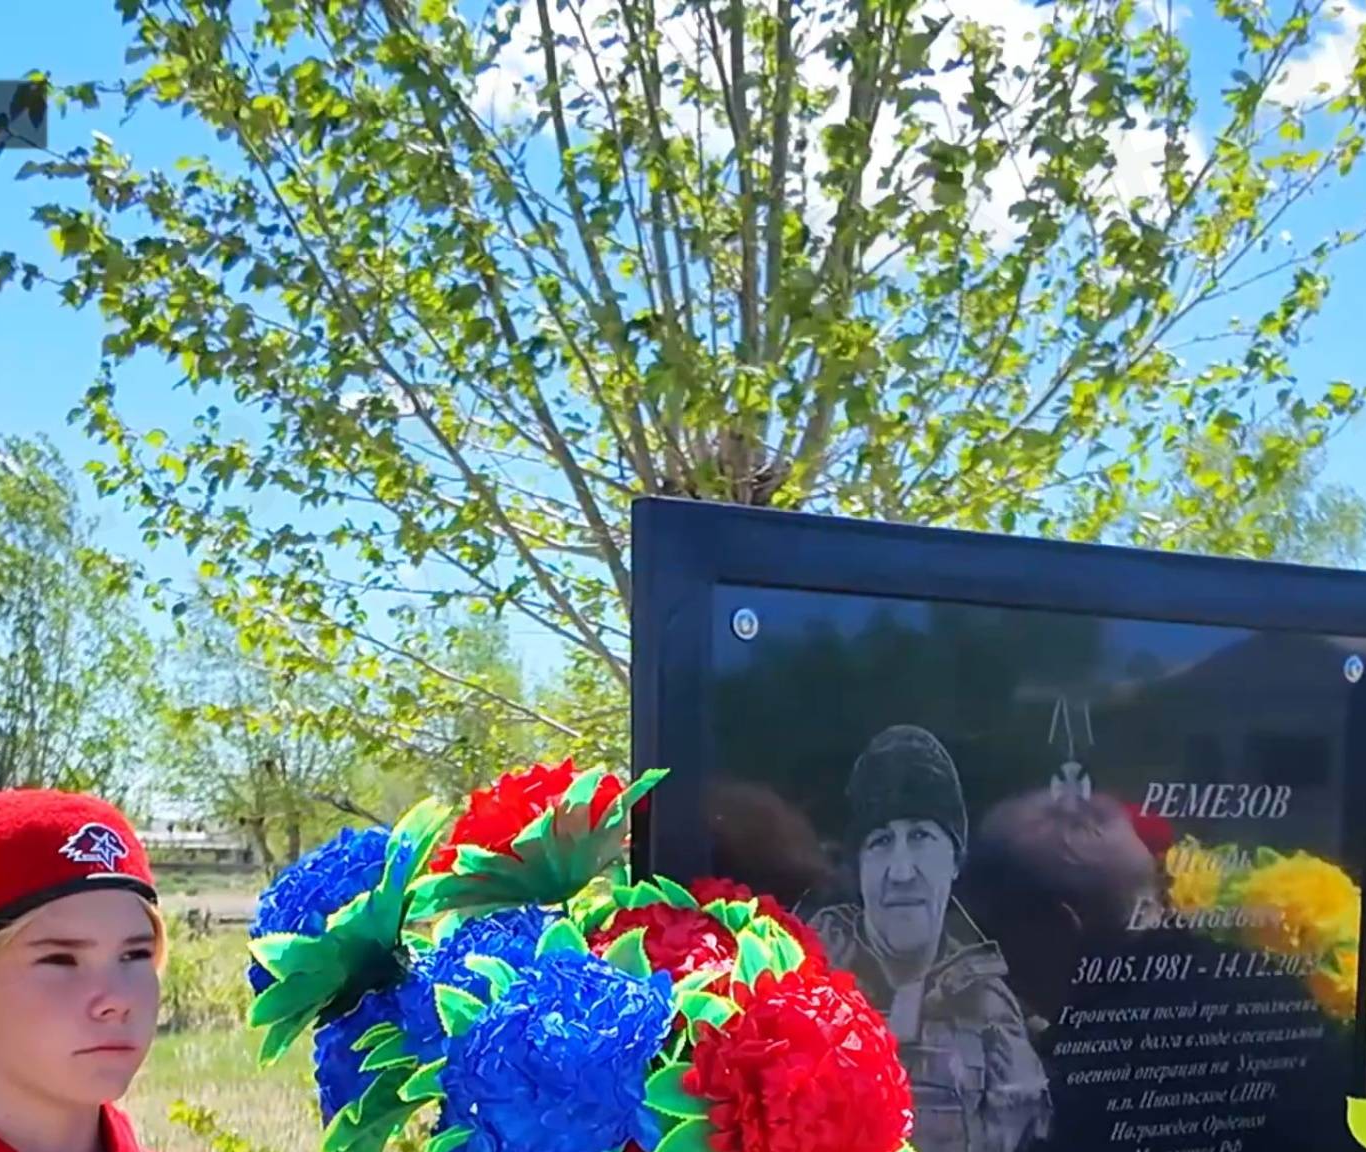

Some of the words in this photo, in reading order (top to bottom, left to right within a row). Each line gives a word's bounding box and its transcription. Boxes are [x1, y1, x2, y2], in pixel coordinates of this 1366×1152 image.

[1139, 782, 1292, 818] РЕМЕЗОВ
[1071, 954, 1193, 985] 30.05.1981
[1057, 1005, 1150, 1028] Героически
[1066, 1066, 1133, 1086] военной
